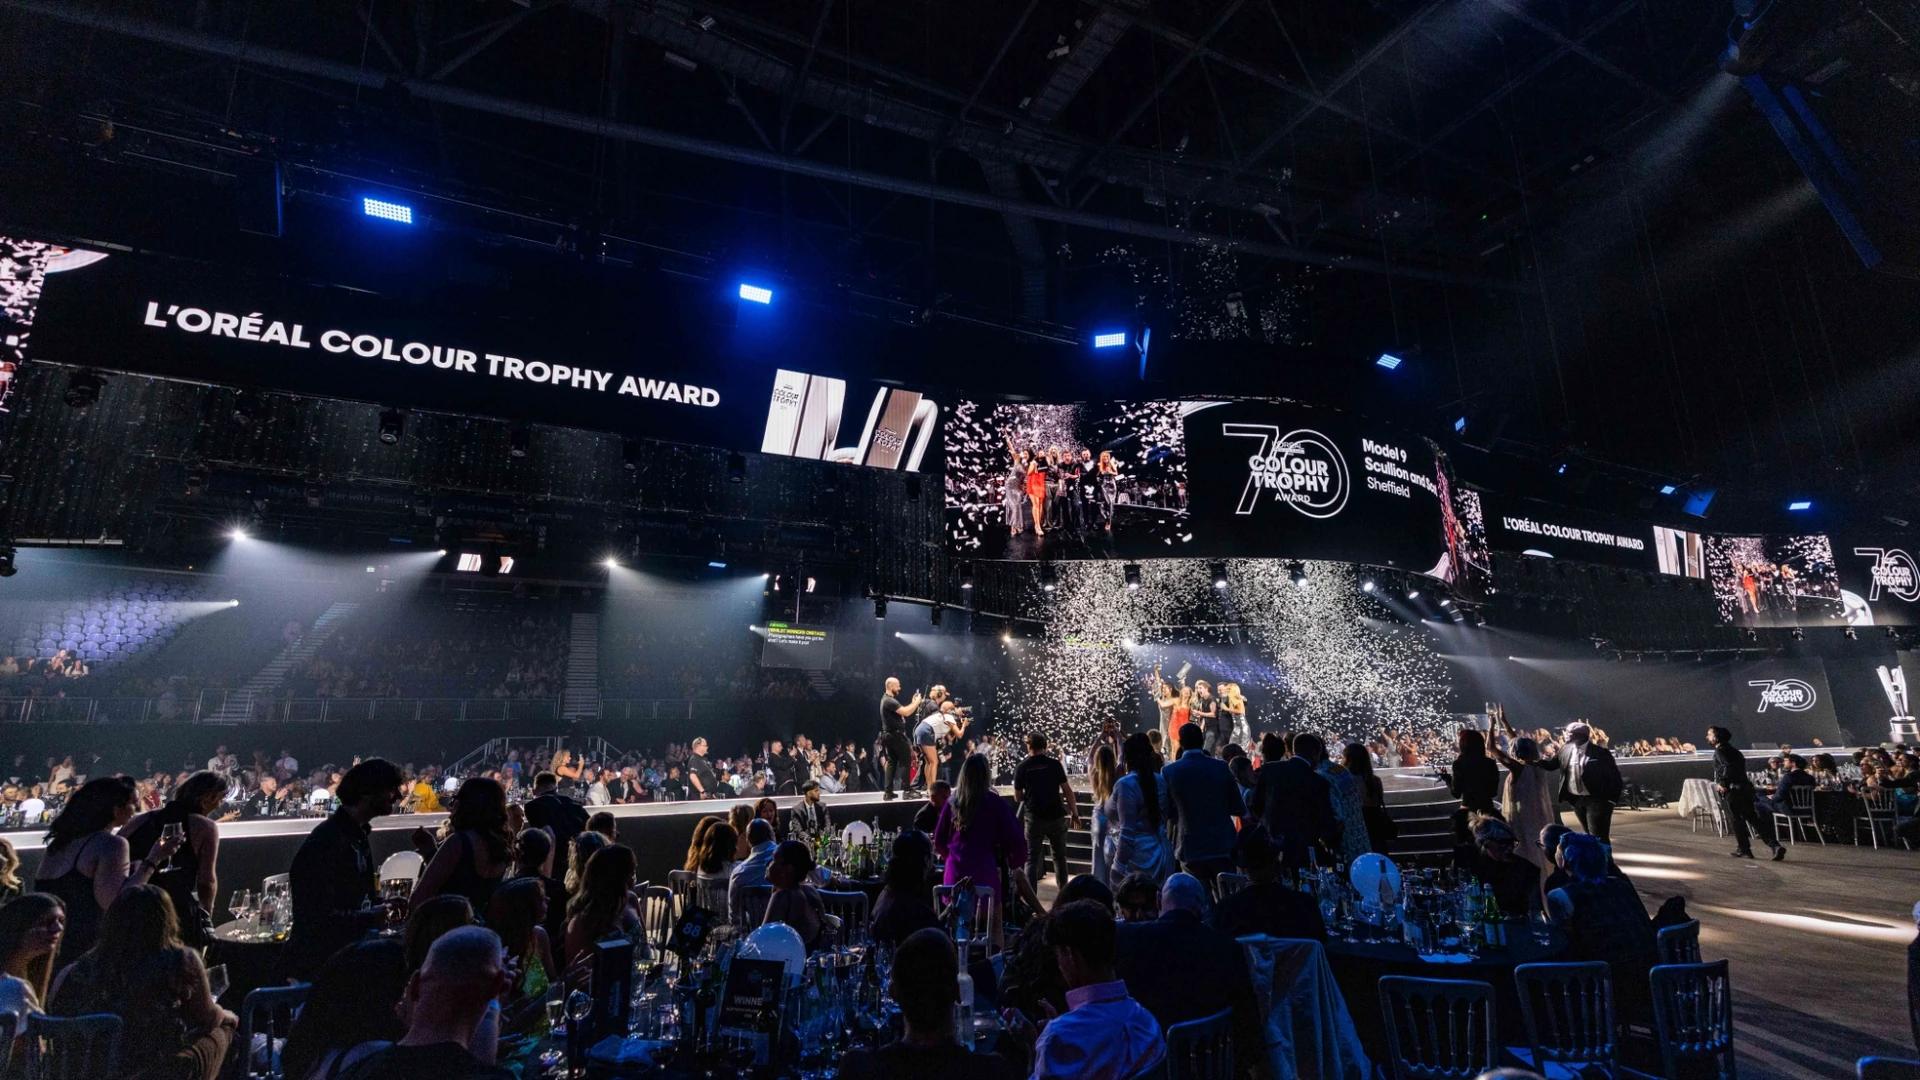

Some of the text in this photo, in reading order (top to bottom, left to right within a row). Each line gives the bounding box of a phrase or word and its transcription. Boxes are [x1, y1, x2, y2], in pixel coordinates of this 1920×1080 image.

[144, 301, 721, 409] L'ORÉAL COLOUR TROPHY AWARD
[1361, 438, 1408, 463] Model 9
[1222, 423, 1351, 519] 70
[1248, 454, 1329, 477] COLOUR
[1364, 456, 1409, 481] Scullion
[1409, 471, 1426, 488] and
[1250, 470, 1330, 493] TROPHY
[1366, 476, 1411, 498] Sheffield
[1274, 493, 1311, 503] AWARD
[1542, 523, 1582, 541] COLOUR
[1582, 529, 1615, 546] TROPHY
[1616, 535, 1644, 551] AWARD
[1871, 565, 1911, 577] COLOUR
[1874, 575, 1913, 586] TROPHY
[1761, 689, 1803, 697] COLOUR
[682, 921, 701, 938] 88
[733, 994, 764, 1006] WINNE
